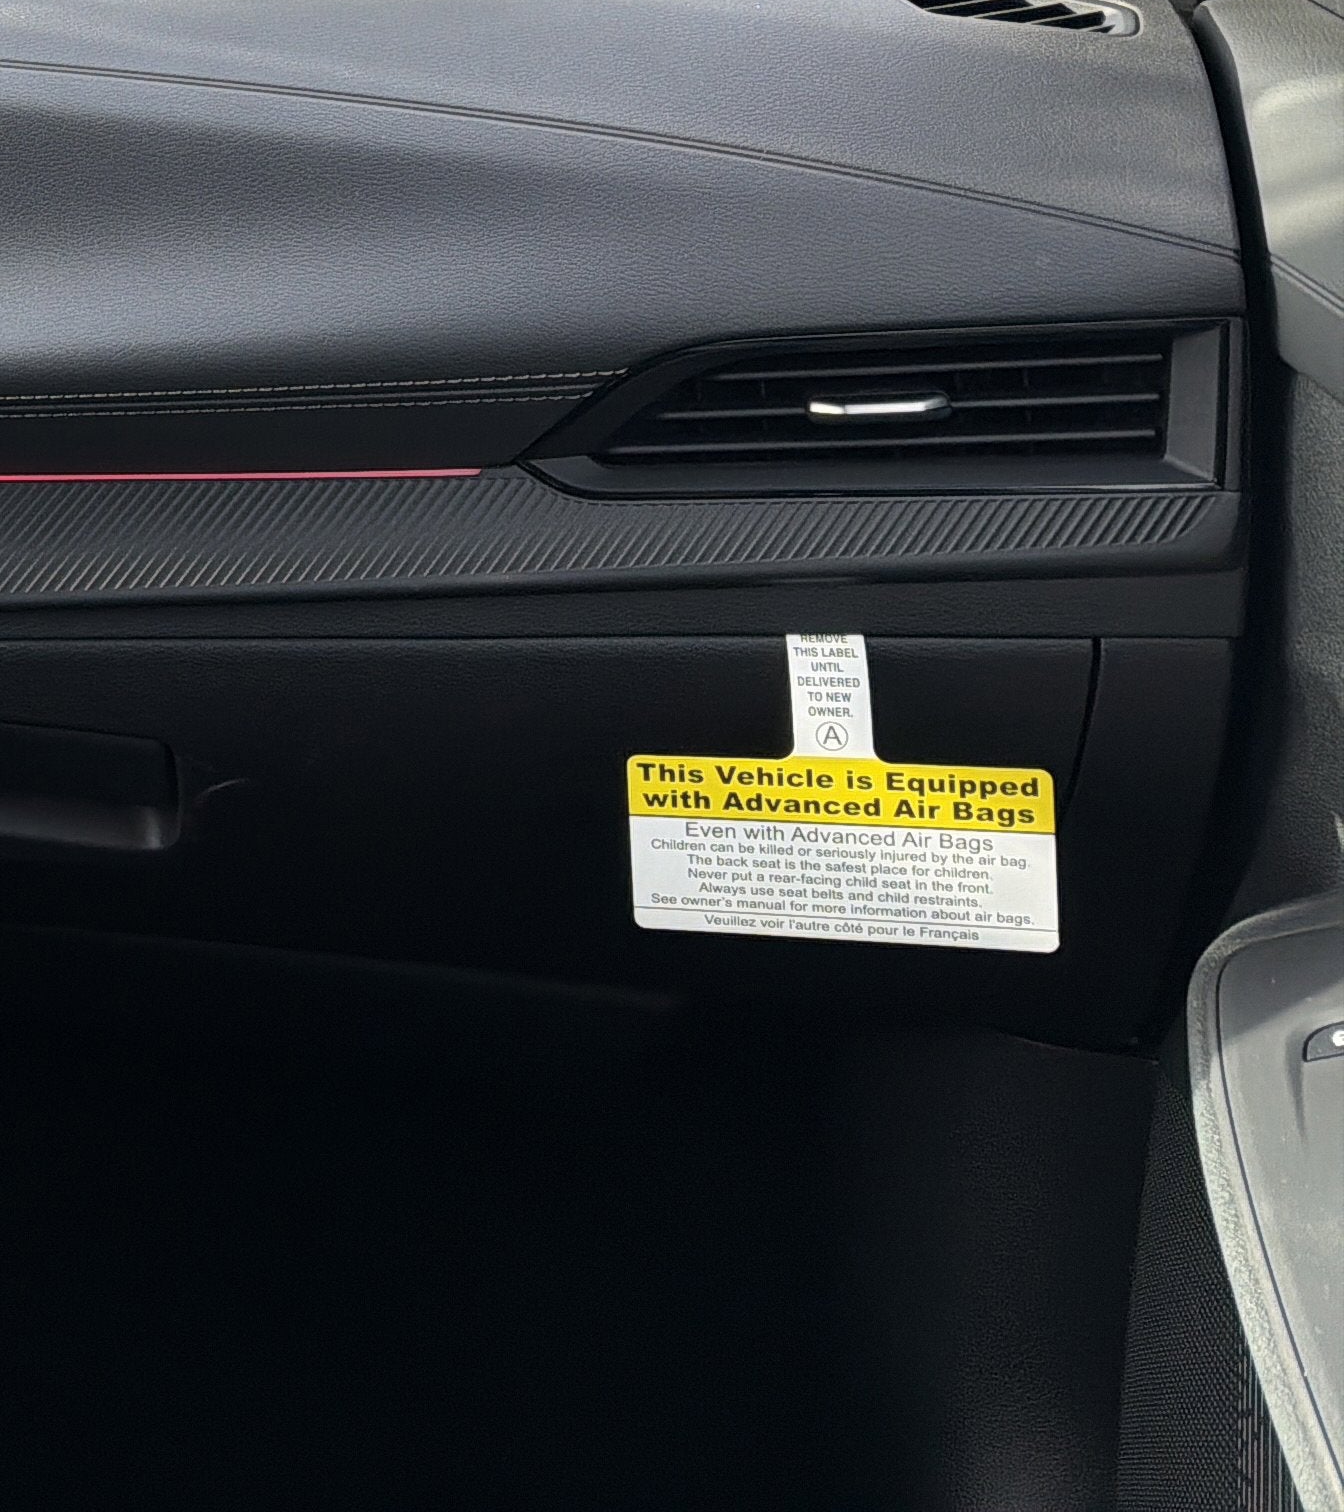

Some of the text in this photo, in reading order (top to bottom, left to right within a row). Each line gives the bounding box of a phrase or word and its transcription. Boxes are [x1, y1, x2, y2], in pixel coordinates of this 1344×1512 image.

[793, 646, 859, 658] THIS LABEL
[811, 661, 844, 672] UNTIL
[797, 675, 860, 688] DELIVERED
[807, 691, 852, 703] TO NEW
[808, 705, 854, 718] OWNER.
[636, 762, 1038, 799] This Vehicle is Equipped
[642, 789, 1035, 827] with Advanced Air Bags
[685, 821, 994, 853] Even with Advanced Air Bags
[651, 838, 1031, 870] Children can be killed or seriously injured by the air bag.
[687, 853, 993, 880] The back seat is the safest place for children.
[688, 868, 993, 894] Never put a rear-facing child seat in the front.
[699, 881, 982, 908] Always use seat belts and child restraints.
[651, 892, 1034, 927] See owner's manual for more information about air bags.
[704, 913, 980, 942] Veuillez voir l'autre côté pour le Français
